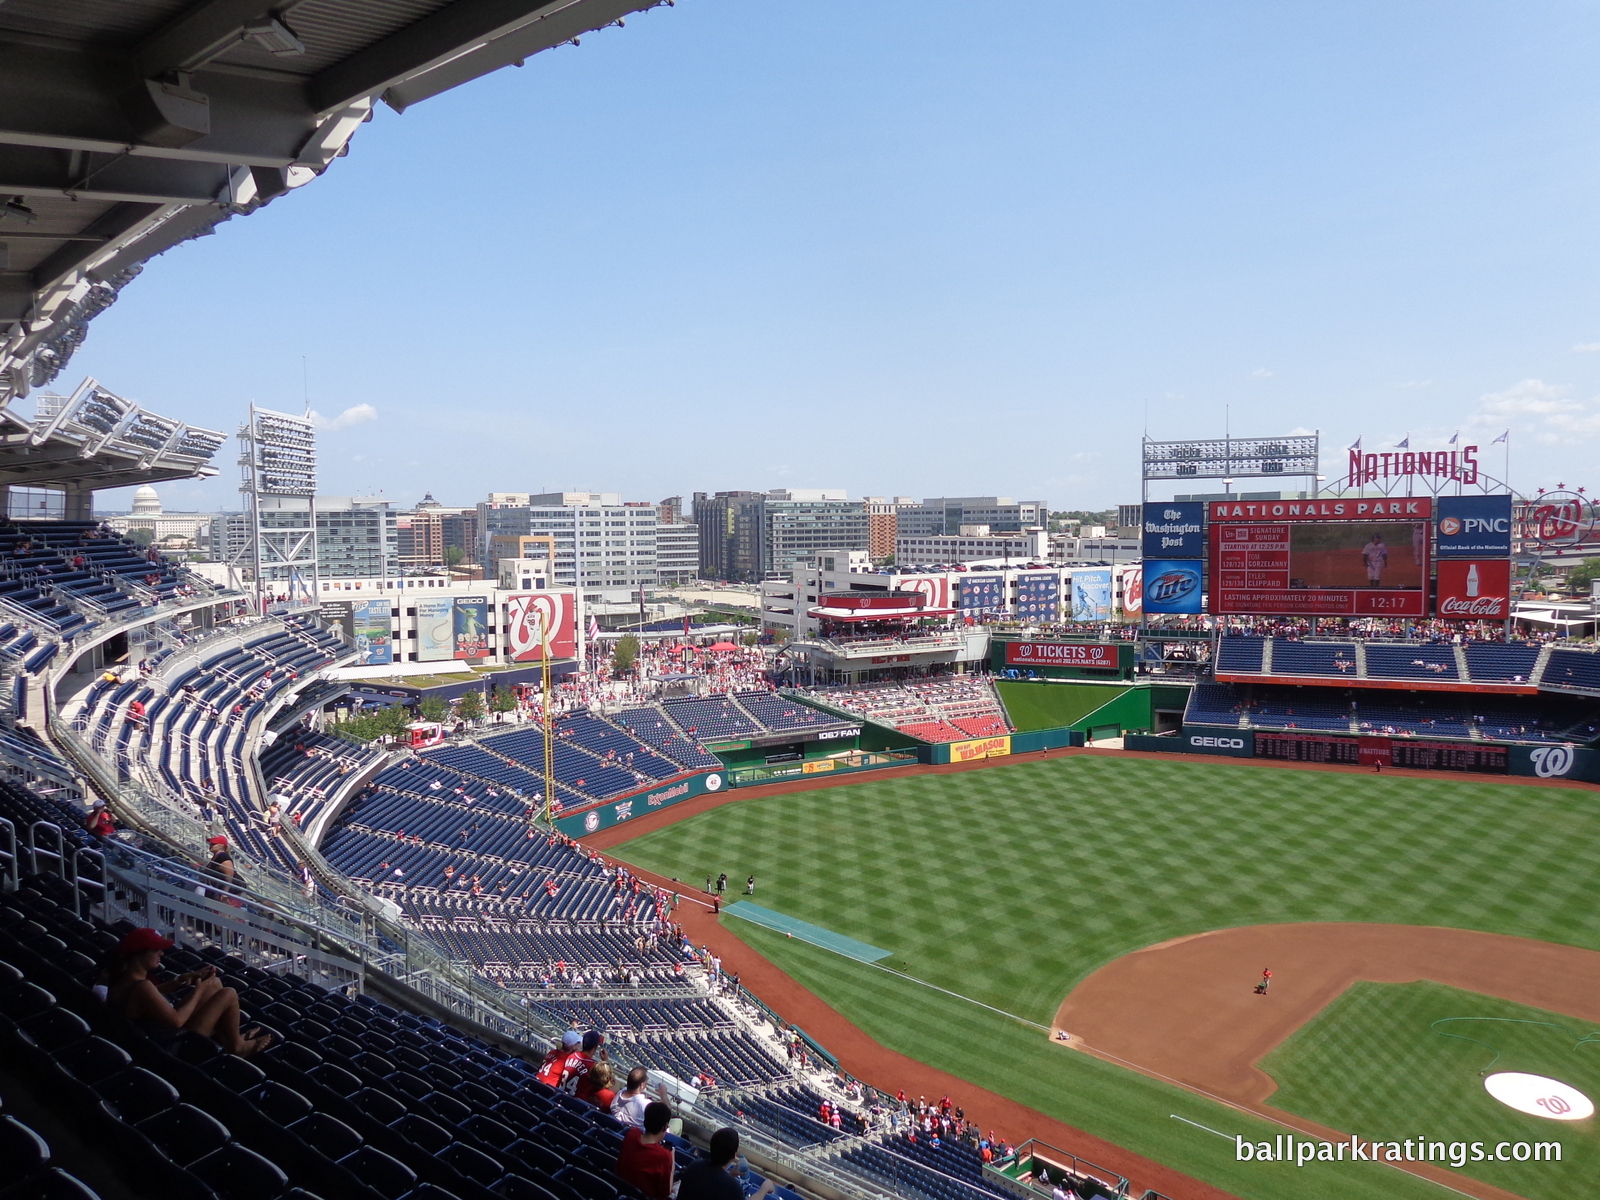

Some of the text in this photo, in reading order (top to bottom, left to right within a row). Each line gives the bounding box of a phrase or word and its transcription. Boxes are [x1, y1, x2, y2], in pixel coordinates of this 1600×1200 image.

[1349, 445, 1478, 487] NATIONALS
[1163, 509, 1182, 521] The
[1216, 502, 1419, 517] NATIONALS PARK
[1145, 521, 1201, 535] Washington
[1463, 518, 1509, 533] PNC
[1161, 537, 1184, 550] Post
[1081, 582, 1110, 590] Discover.
[1371, 597, 1406, 608] 12:17
[1440, 596, 1505, 615] Coca-Cola
[1036, 645, 1086, 658] TICKETS
[840, 728, 860, 736] FAN
[1190, 736, 1244, 748] GEICO
